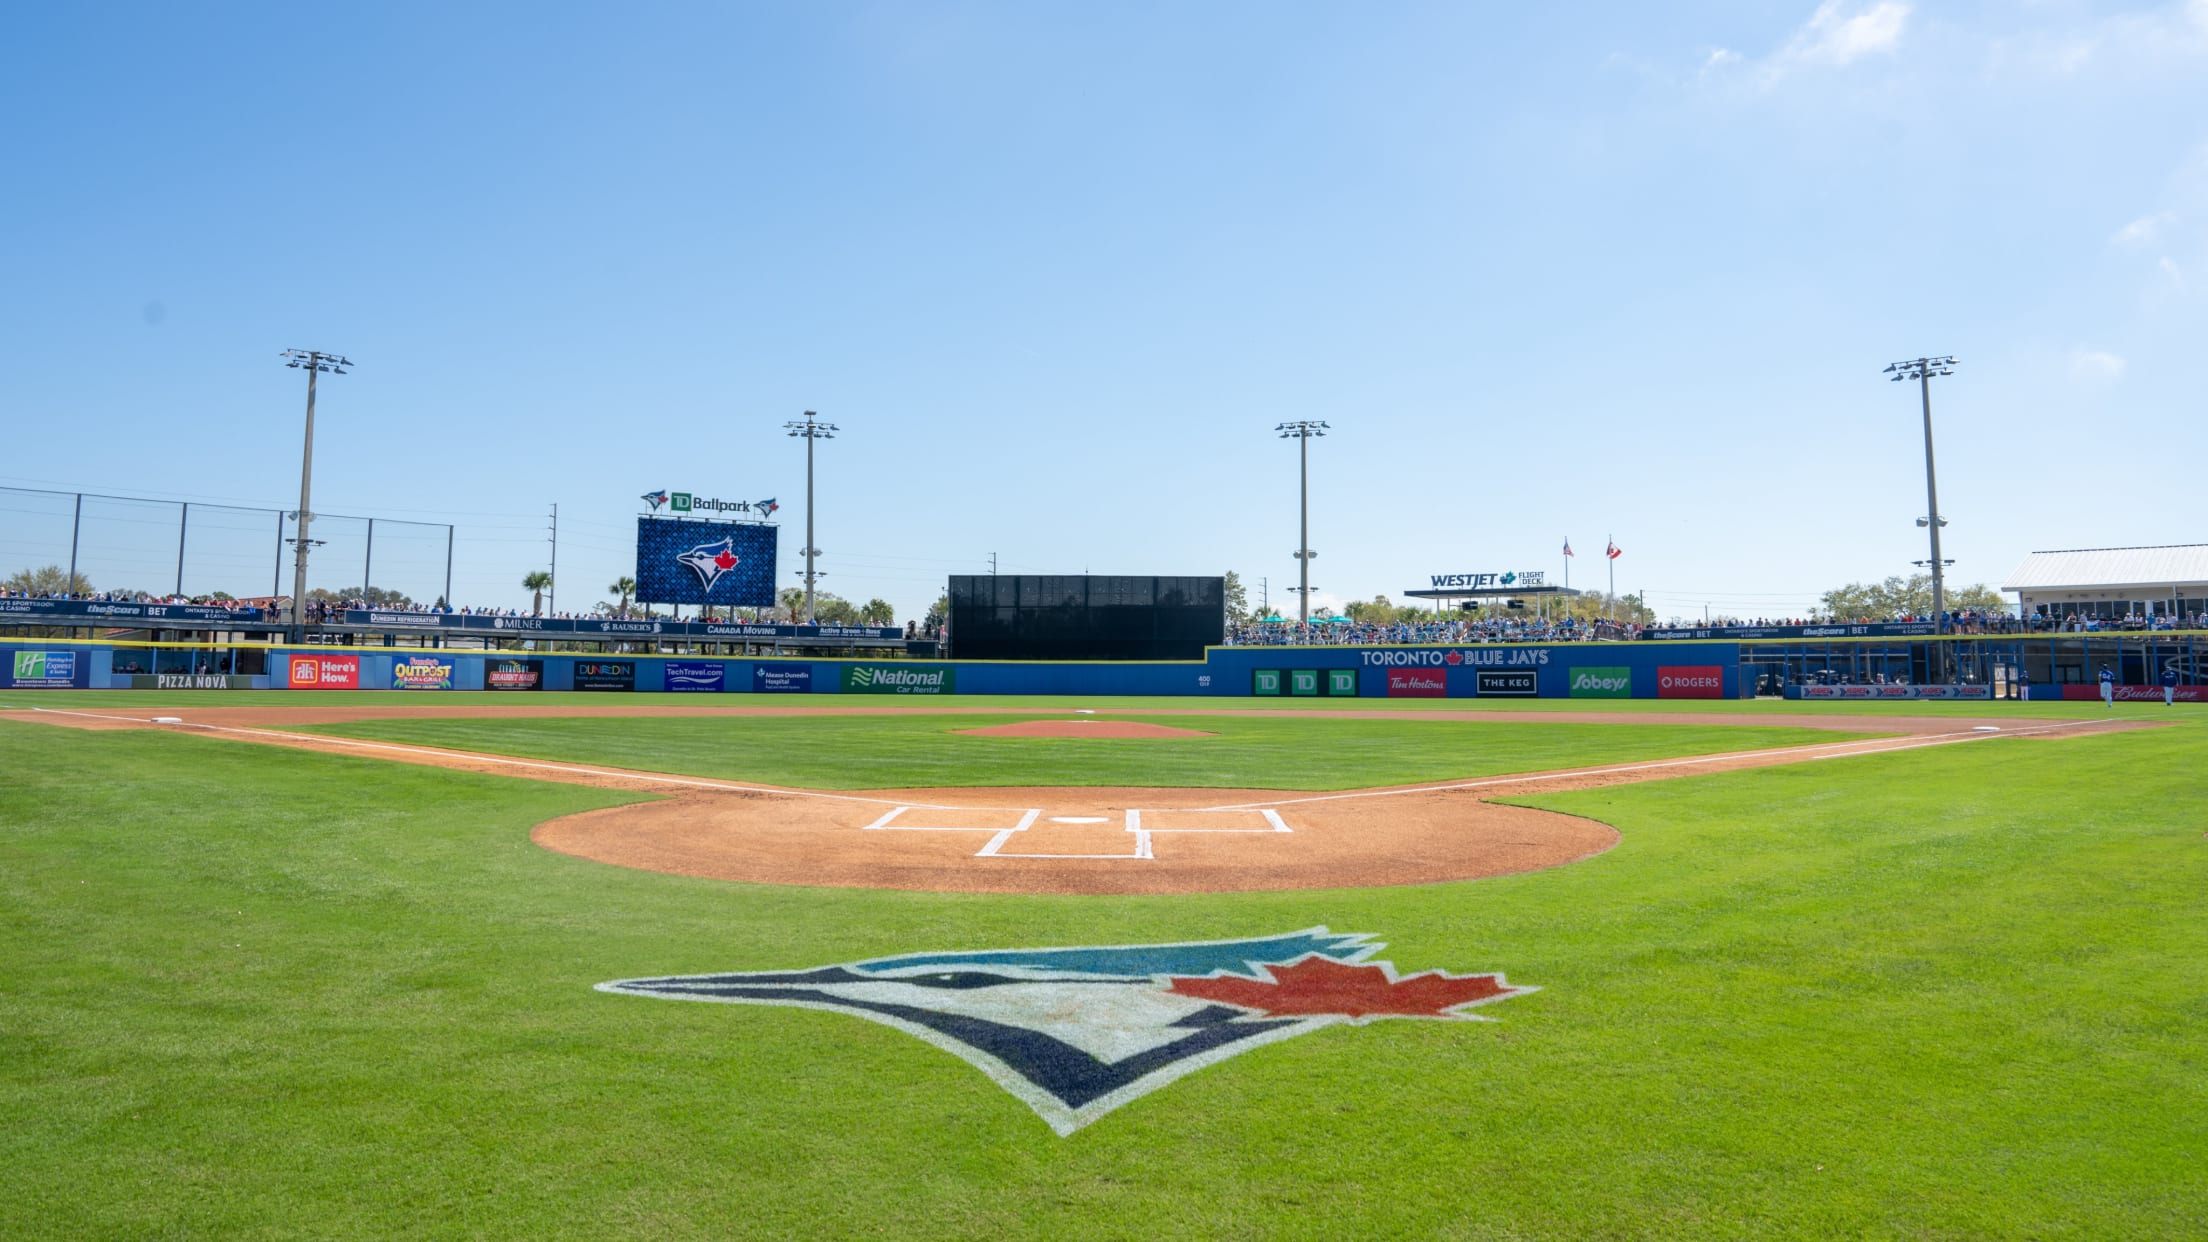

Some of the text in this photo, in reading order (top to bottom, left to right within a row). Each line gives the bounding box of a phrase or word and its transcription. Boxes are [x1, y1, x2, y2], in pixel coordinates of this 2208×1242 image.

[673, 495, 751, 513] TD Ballpark
[1518, 571, 1544, 579] FLIGHT
[1431, 573, 1498, 590] WESTJET
[87, 604, 167, 616] theScore BET
[370, 613, 396, 623] DUNEDIN
[505, 619, 542, 630] MILNER
[612, 623, 651, 632] BAUSER'S
[707, 625, 776, 635] CANADA MOVING
[1653, 630, 1711, 639] theScore BET
[1803, 626, 1868, 635] theScore BET
[1361, 649, 1549, 666] TORONTO BLUE JAYS
[321, 661, 356, 672] Here's
[395, 663, 452, 678] OUTPOST
[579, 664, 631, 675] DUNEDIN
[666, 668, 723, 676] TechTravel.com
[158, 675, 227, 689] PIZZA NOVA
[321, 672, 349, 683] How.
[766, 678, 789, 686] Hospital
[1257, 675, 1277, 690] TD
[1295, 675, 1315, 690] TD
[1332, 675, 1353, 690] TD
[1391, 677, 1444, 689] Tim Hortons
[1484, 679, 1530, 687] THE KEG
[1572, 673, 1628, 692] Sobeys
[1674, 677, 1719, 688] ROGERS
[913, 686, 940, 694] Rental
